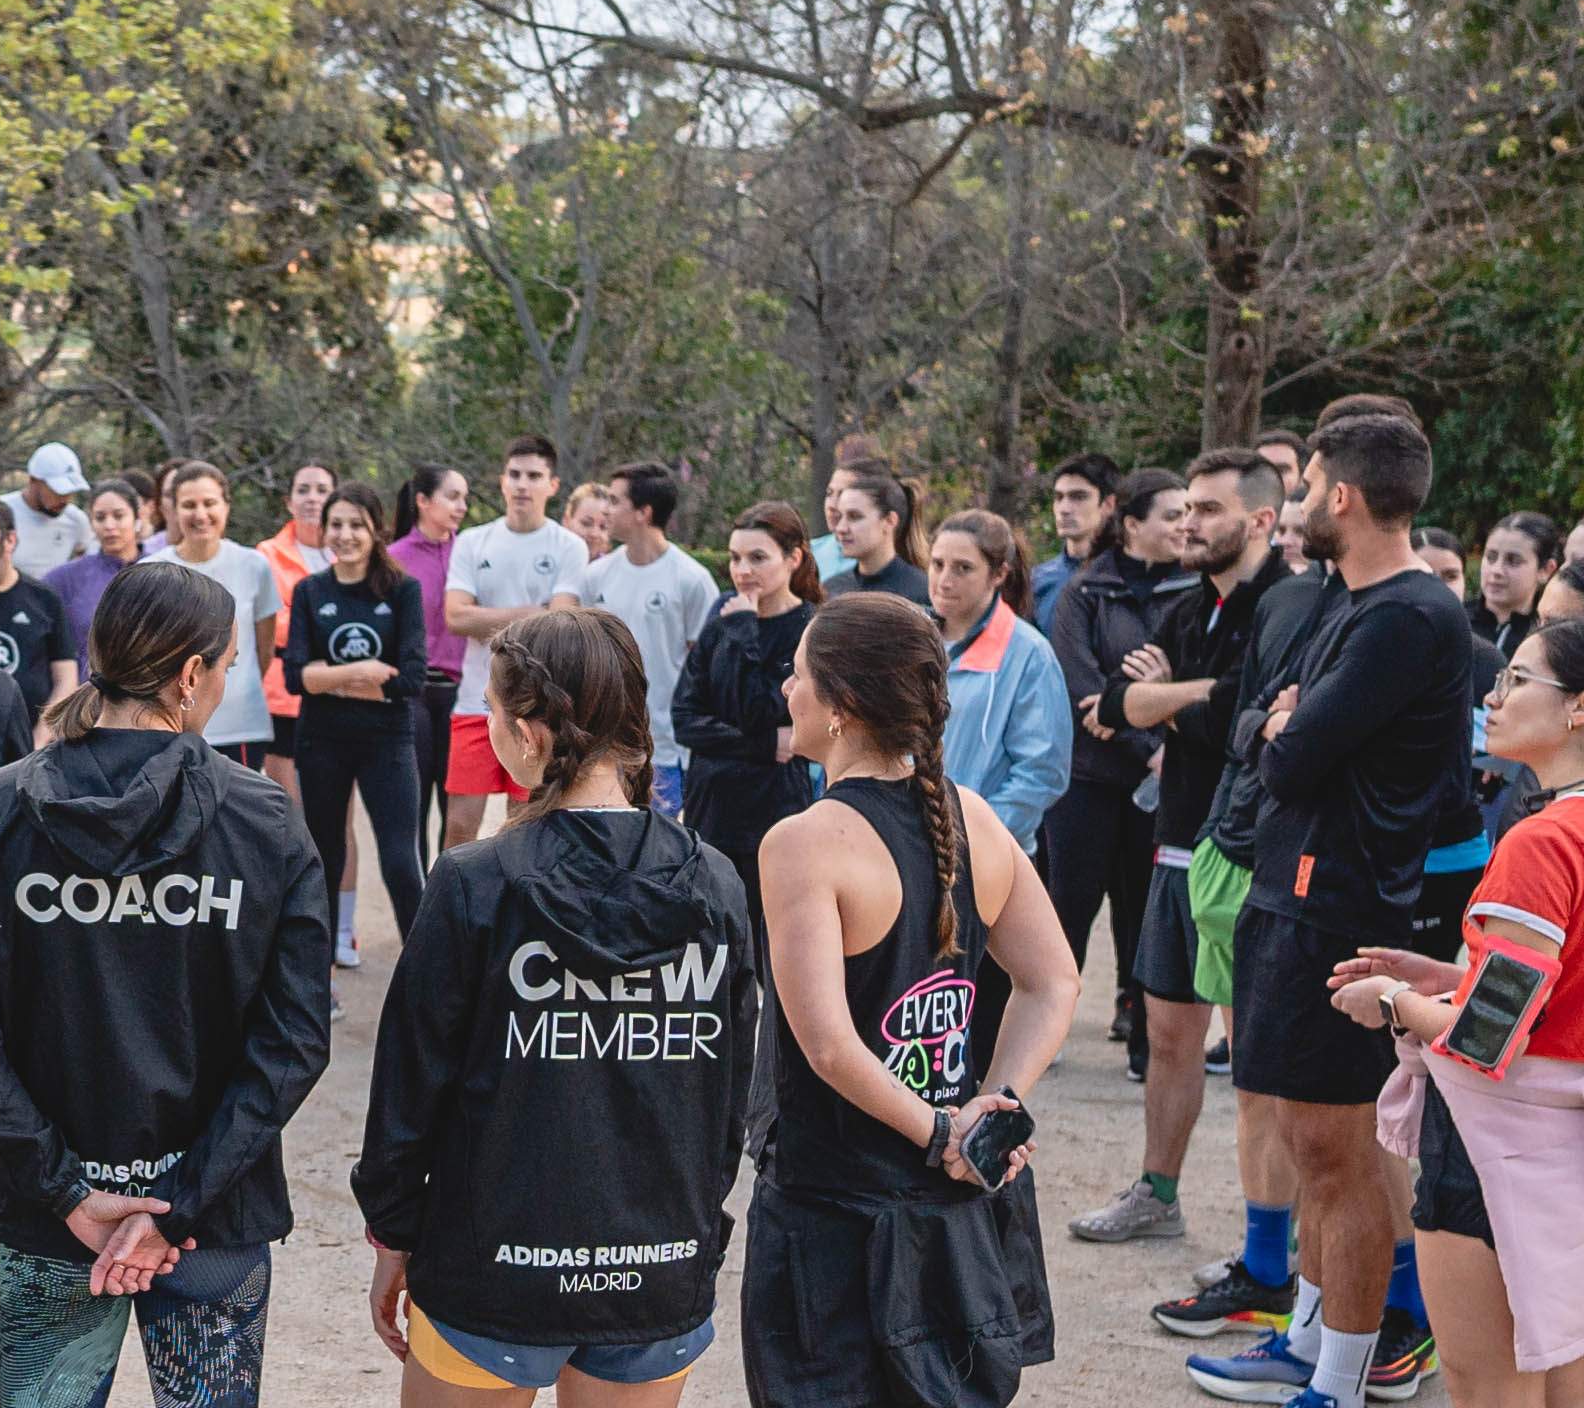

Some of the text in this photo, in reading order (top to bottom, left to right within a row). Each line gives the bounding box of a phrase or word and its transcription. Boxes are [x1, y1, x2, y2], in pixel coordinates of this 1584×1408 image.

[14, 872, 244, 930] COACH
[901, 988, 969, 1038] EVERY
[505, 1010, 723, 1061] MEMBER
[934, 1085, 961, 1103] place
[494, 1239, 699, 1267] ADIDAS RUNNERS
[559, 1271, 642, 1294] MADRID
